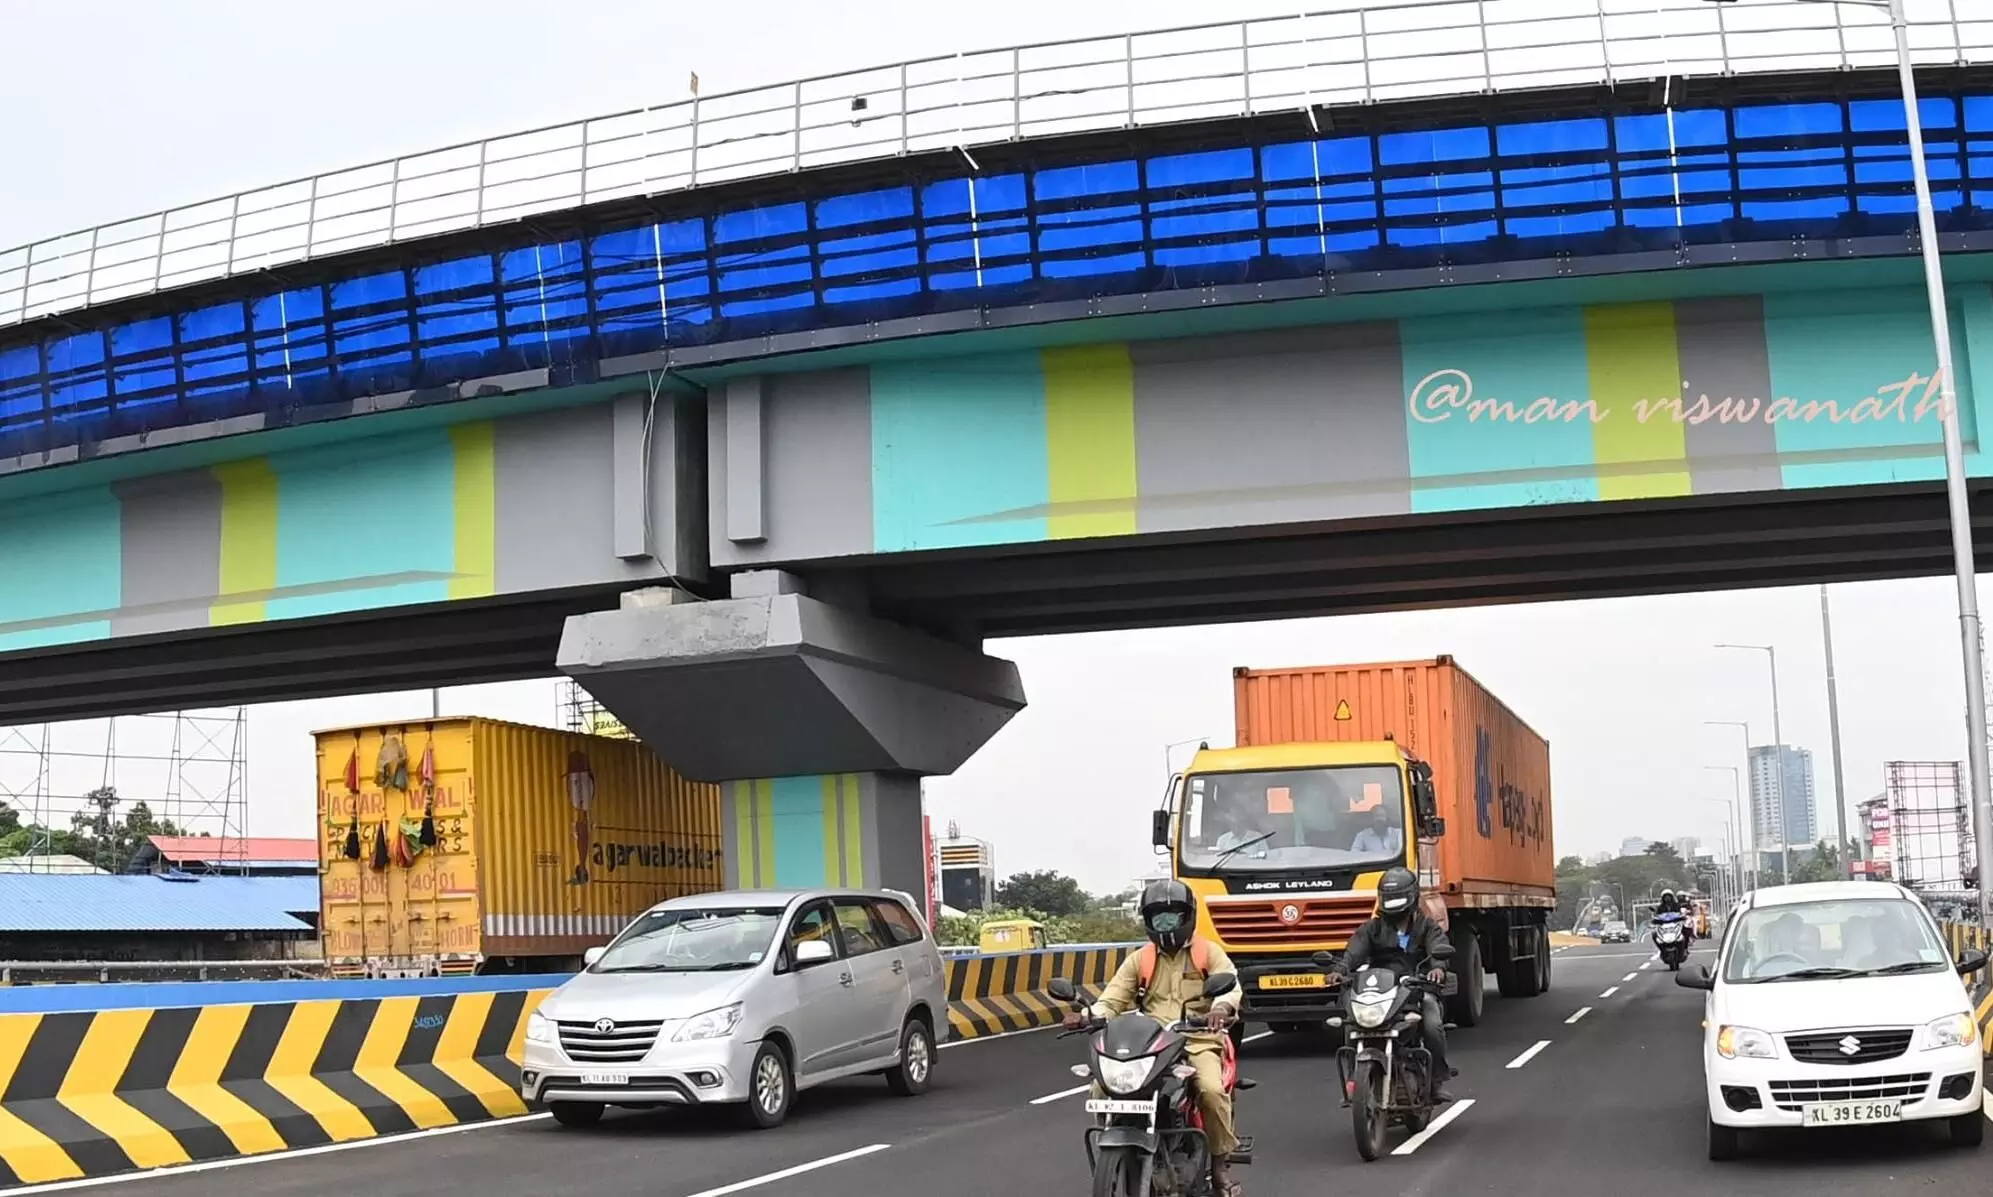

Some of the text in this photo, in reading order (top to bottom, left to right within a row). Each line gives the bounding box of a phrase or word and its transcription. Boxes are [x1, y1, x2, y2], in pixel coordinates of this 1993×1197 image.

[1245, 880, 1334, 890] ASHOK LEYLAND
[1812, 1103, 1900, 1122] KL 39 E 2604
